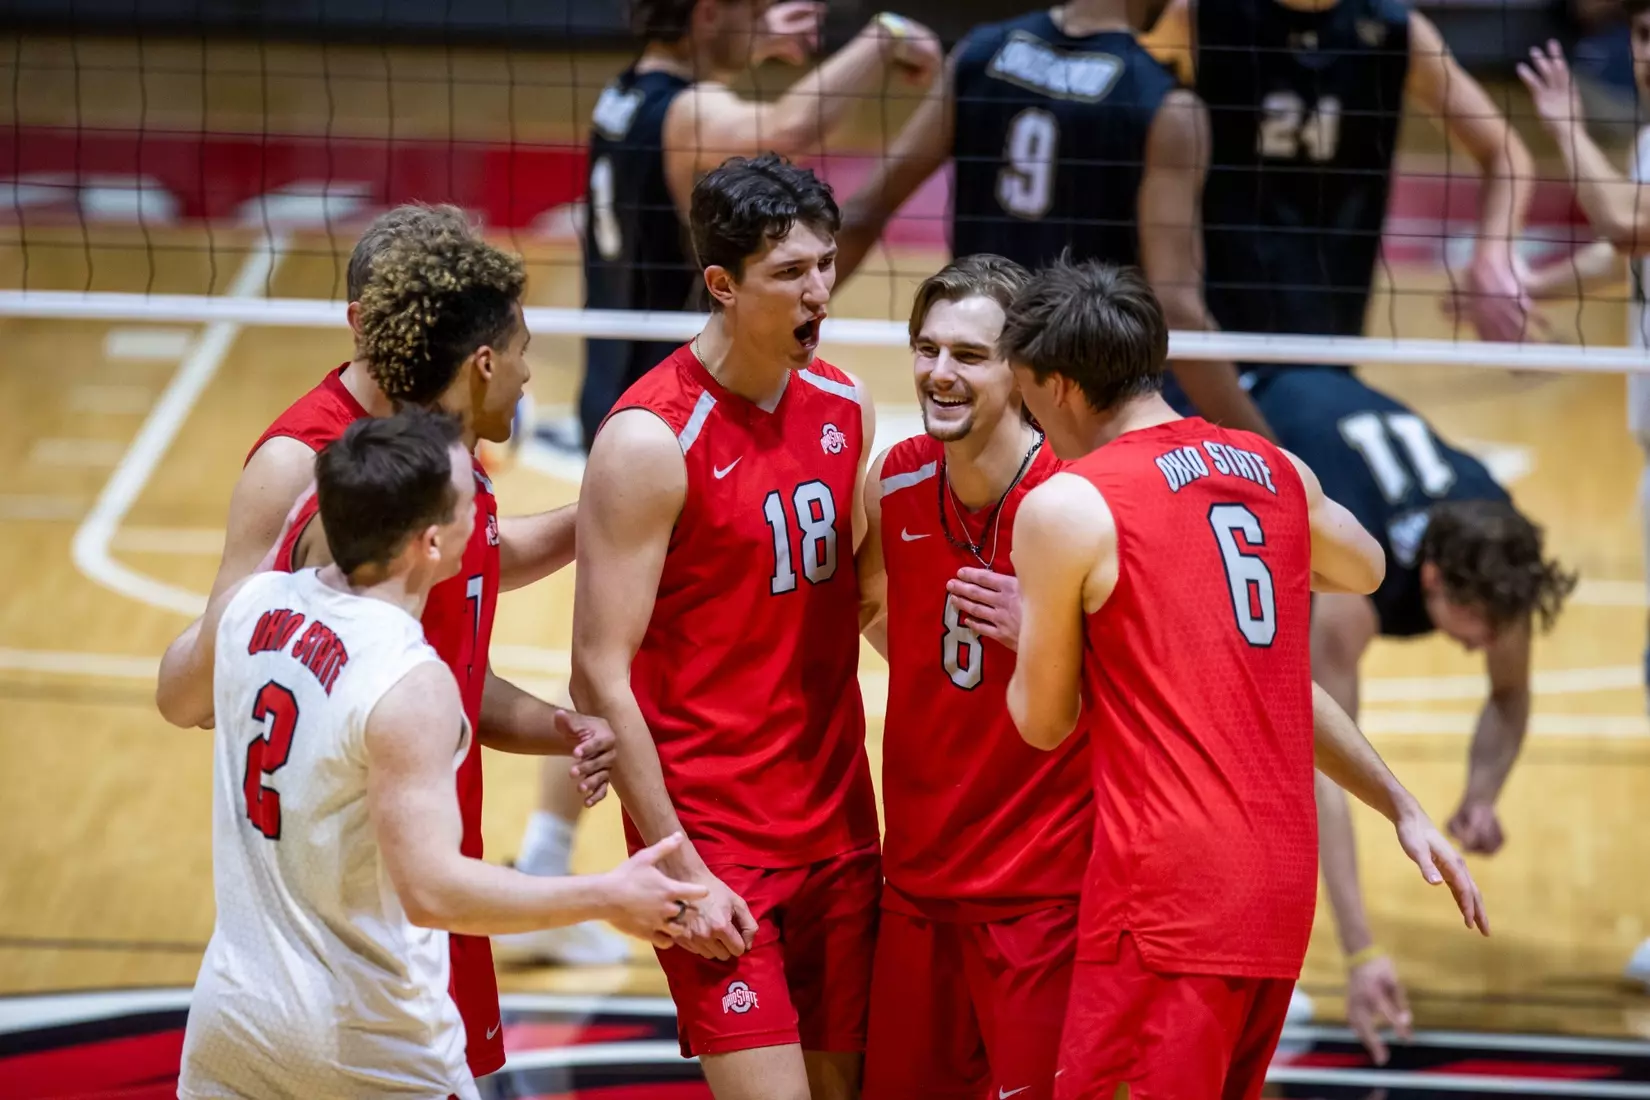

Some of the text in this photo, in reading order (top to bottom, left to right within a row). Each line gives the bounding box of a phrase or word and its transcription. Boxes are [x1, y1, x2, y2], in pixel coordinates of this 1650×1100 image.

[996, 107, 1060, 220] 9
[1154, 440, 1277, 494] OHIO STATE
[1337, 410, 1457, 504] 11
[763, 478, 837, 596] 18
[1207, 502, 1278, 648] 6
[247, 608, 349, 698] OHIO STATE
[941, 590, 984, 691] 8
[243, 679, 299, 840] 2
